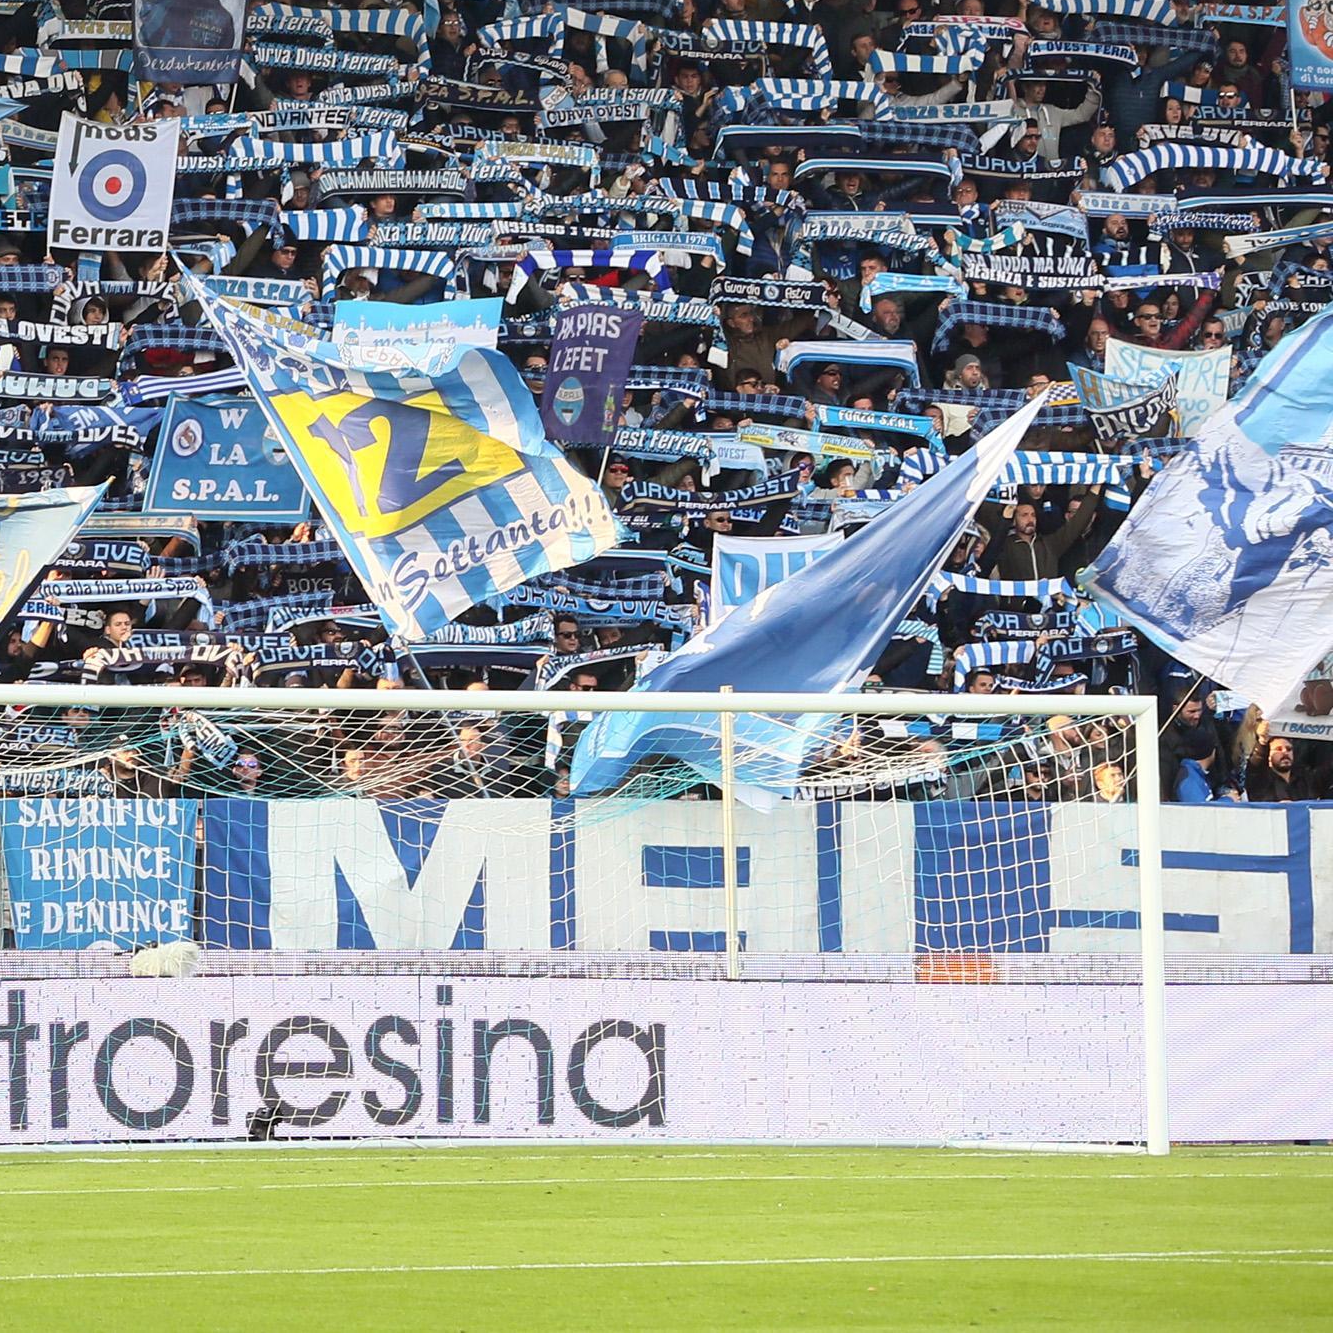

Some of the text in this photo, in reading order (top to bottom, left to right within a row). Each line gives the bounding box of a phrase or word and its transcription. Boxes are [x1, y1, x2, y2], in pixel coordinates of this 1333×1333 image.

[546, 105, 641, 123] CURVA OVEST
[51, 220, 163, 247] Ferrara
[632, 233, 708, 246] BRIGATA 1978
[220, 408, 248, 429] W
[838, 408, 874, 423] FORZA
[210, 442, 248, 465] LA
[171, 477, 280, 502] S.P.A.L.
[127, 578, 163, 594] forza
[31, 847, 171, 881] RINUNCE
[42, 902, 188, 932] DENUNCE
